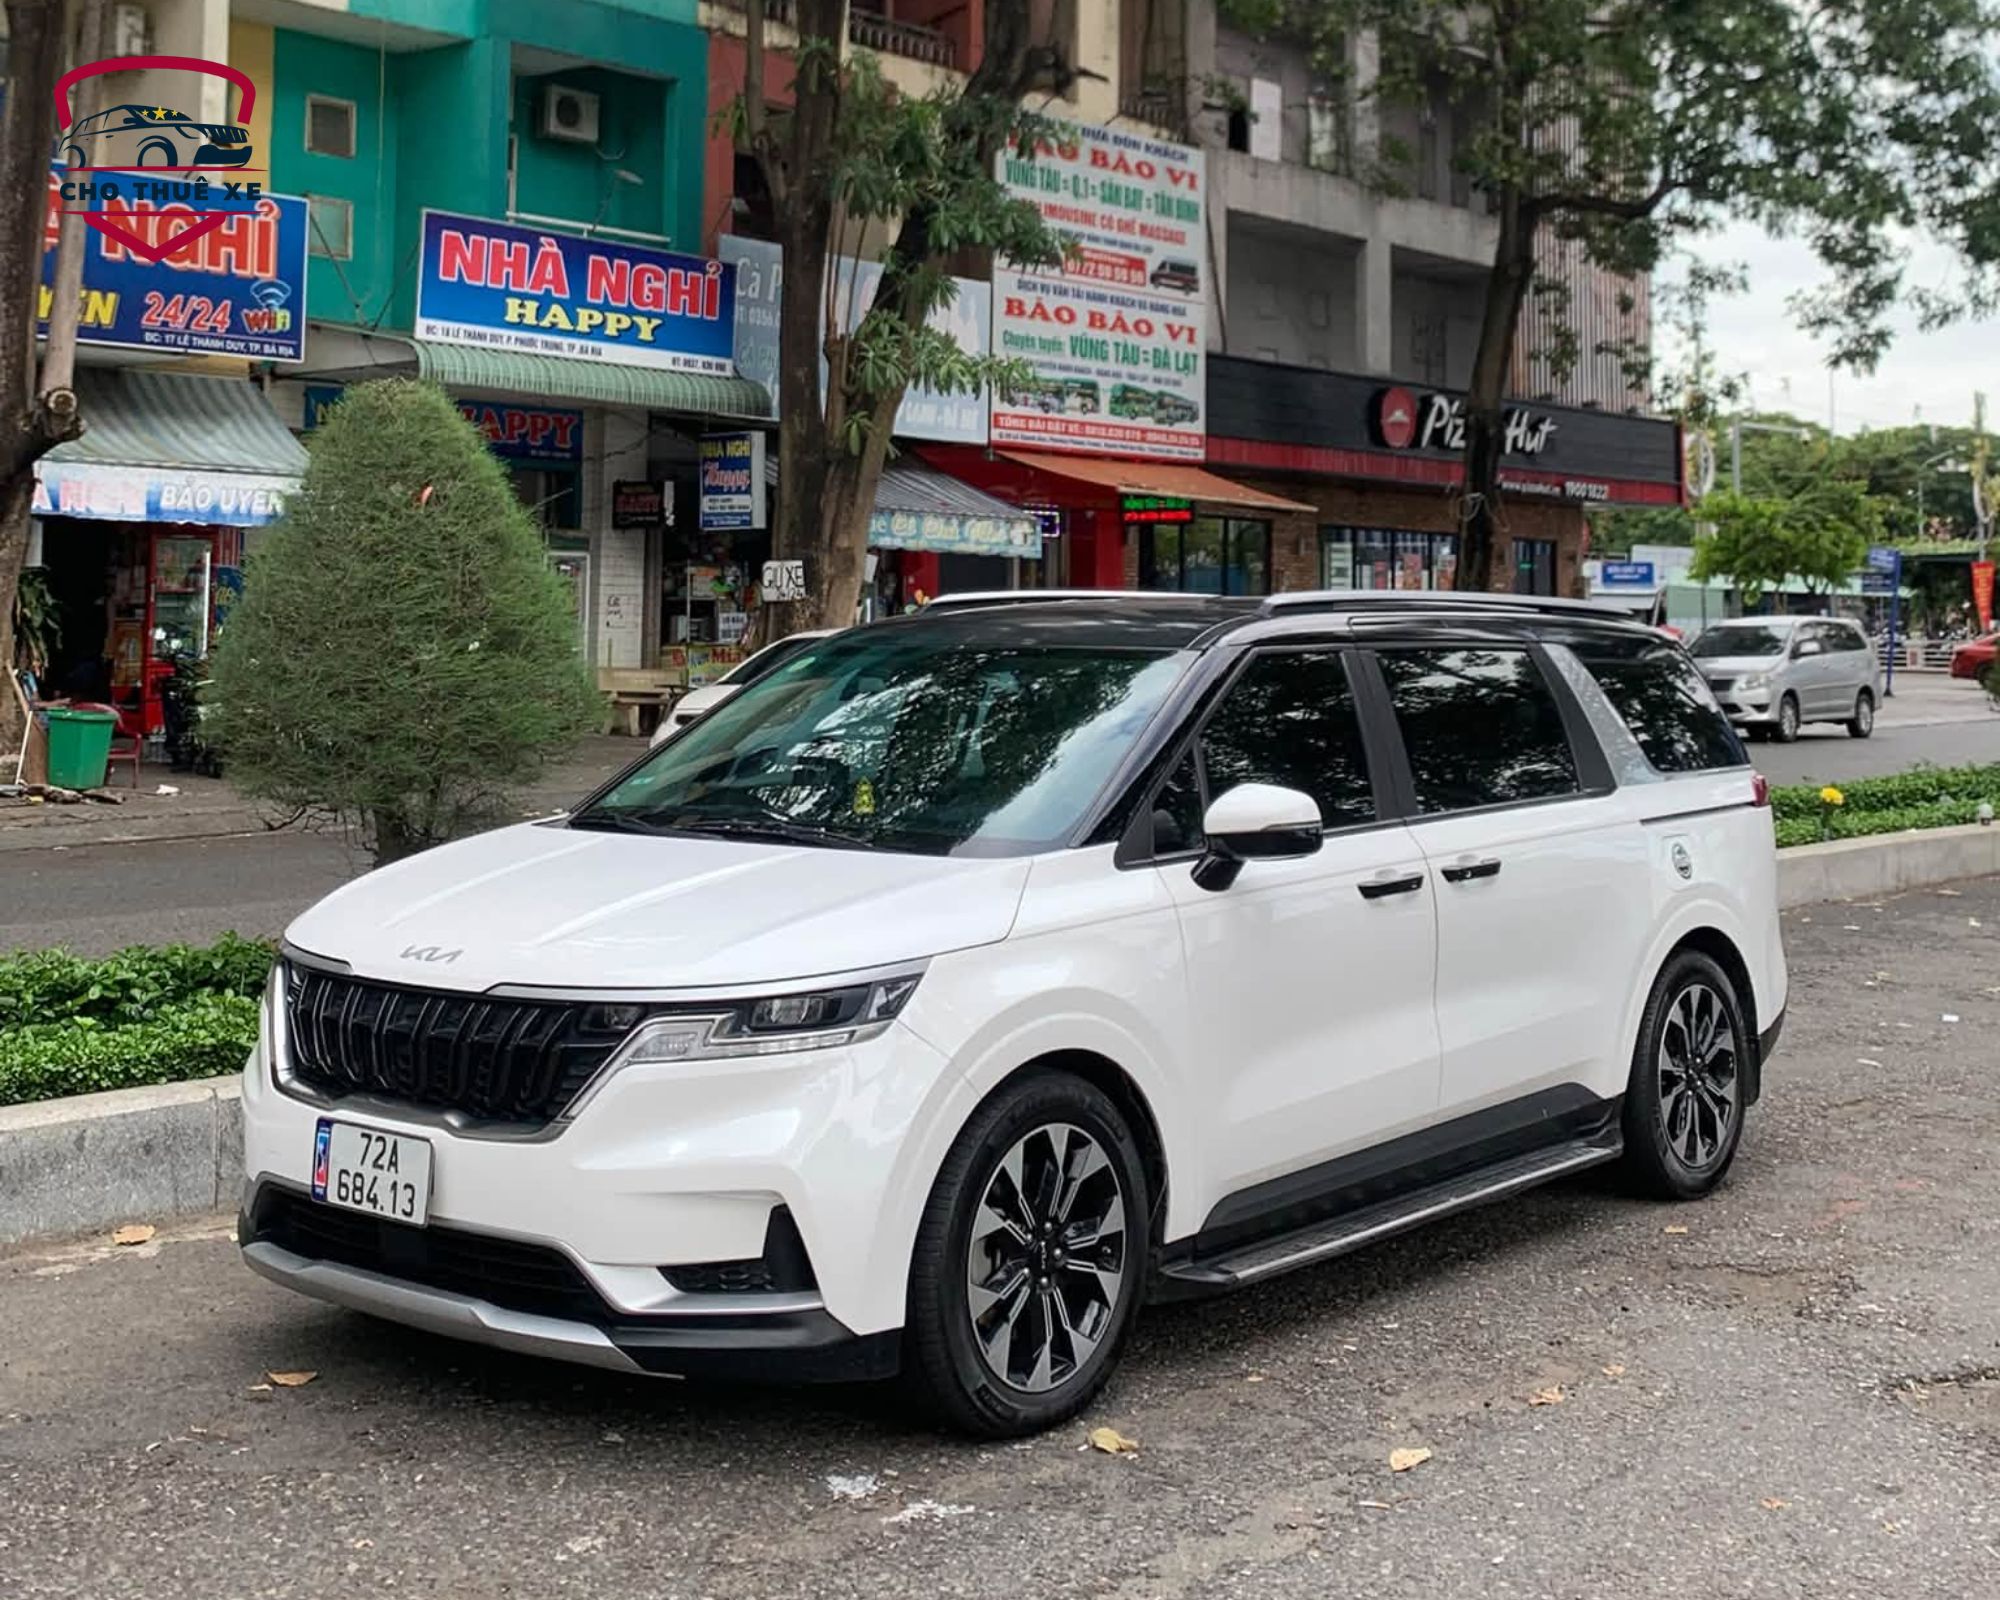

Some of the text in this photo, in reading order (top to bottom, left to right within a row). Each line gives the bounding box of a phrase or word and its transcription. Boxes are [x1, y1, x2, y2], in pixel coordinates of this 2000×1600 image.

[102, 192, 281, 280] NGHỈ
[439, 229, 570, 298] NHÀ
[587, 255, 723, 320] NGHỈ
[141, 291, 232, 333] 24/24
[505, 297, 663, 342] HAPPY
[1004, 296, 1199, 346] BẢO BẢO VI
[1421, 395, 1558, 456] Piz Hut
[360, 1132, 400, 1175] 72A
[336, 1169, 416, 1218] 684.13
